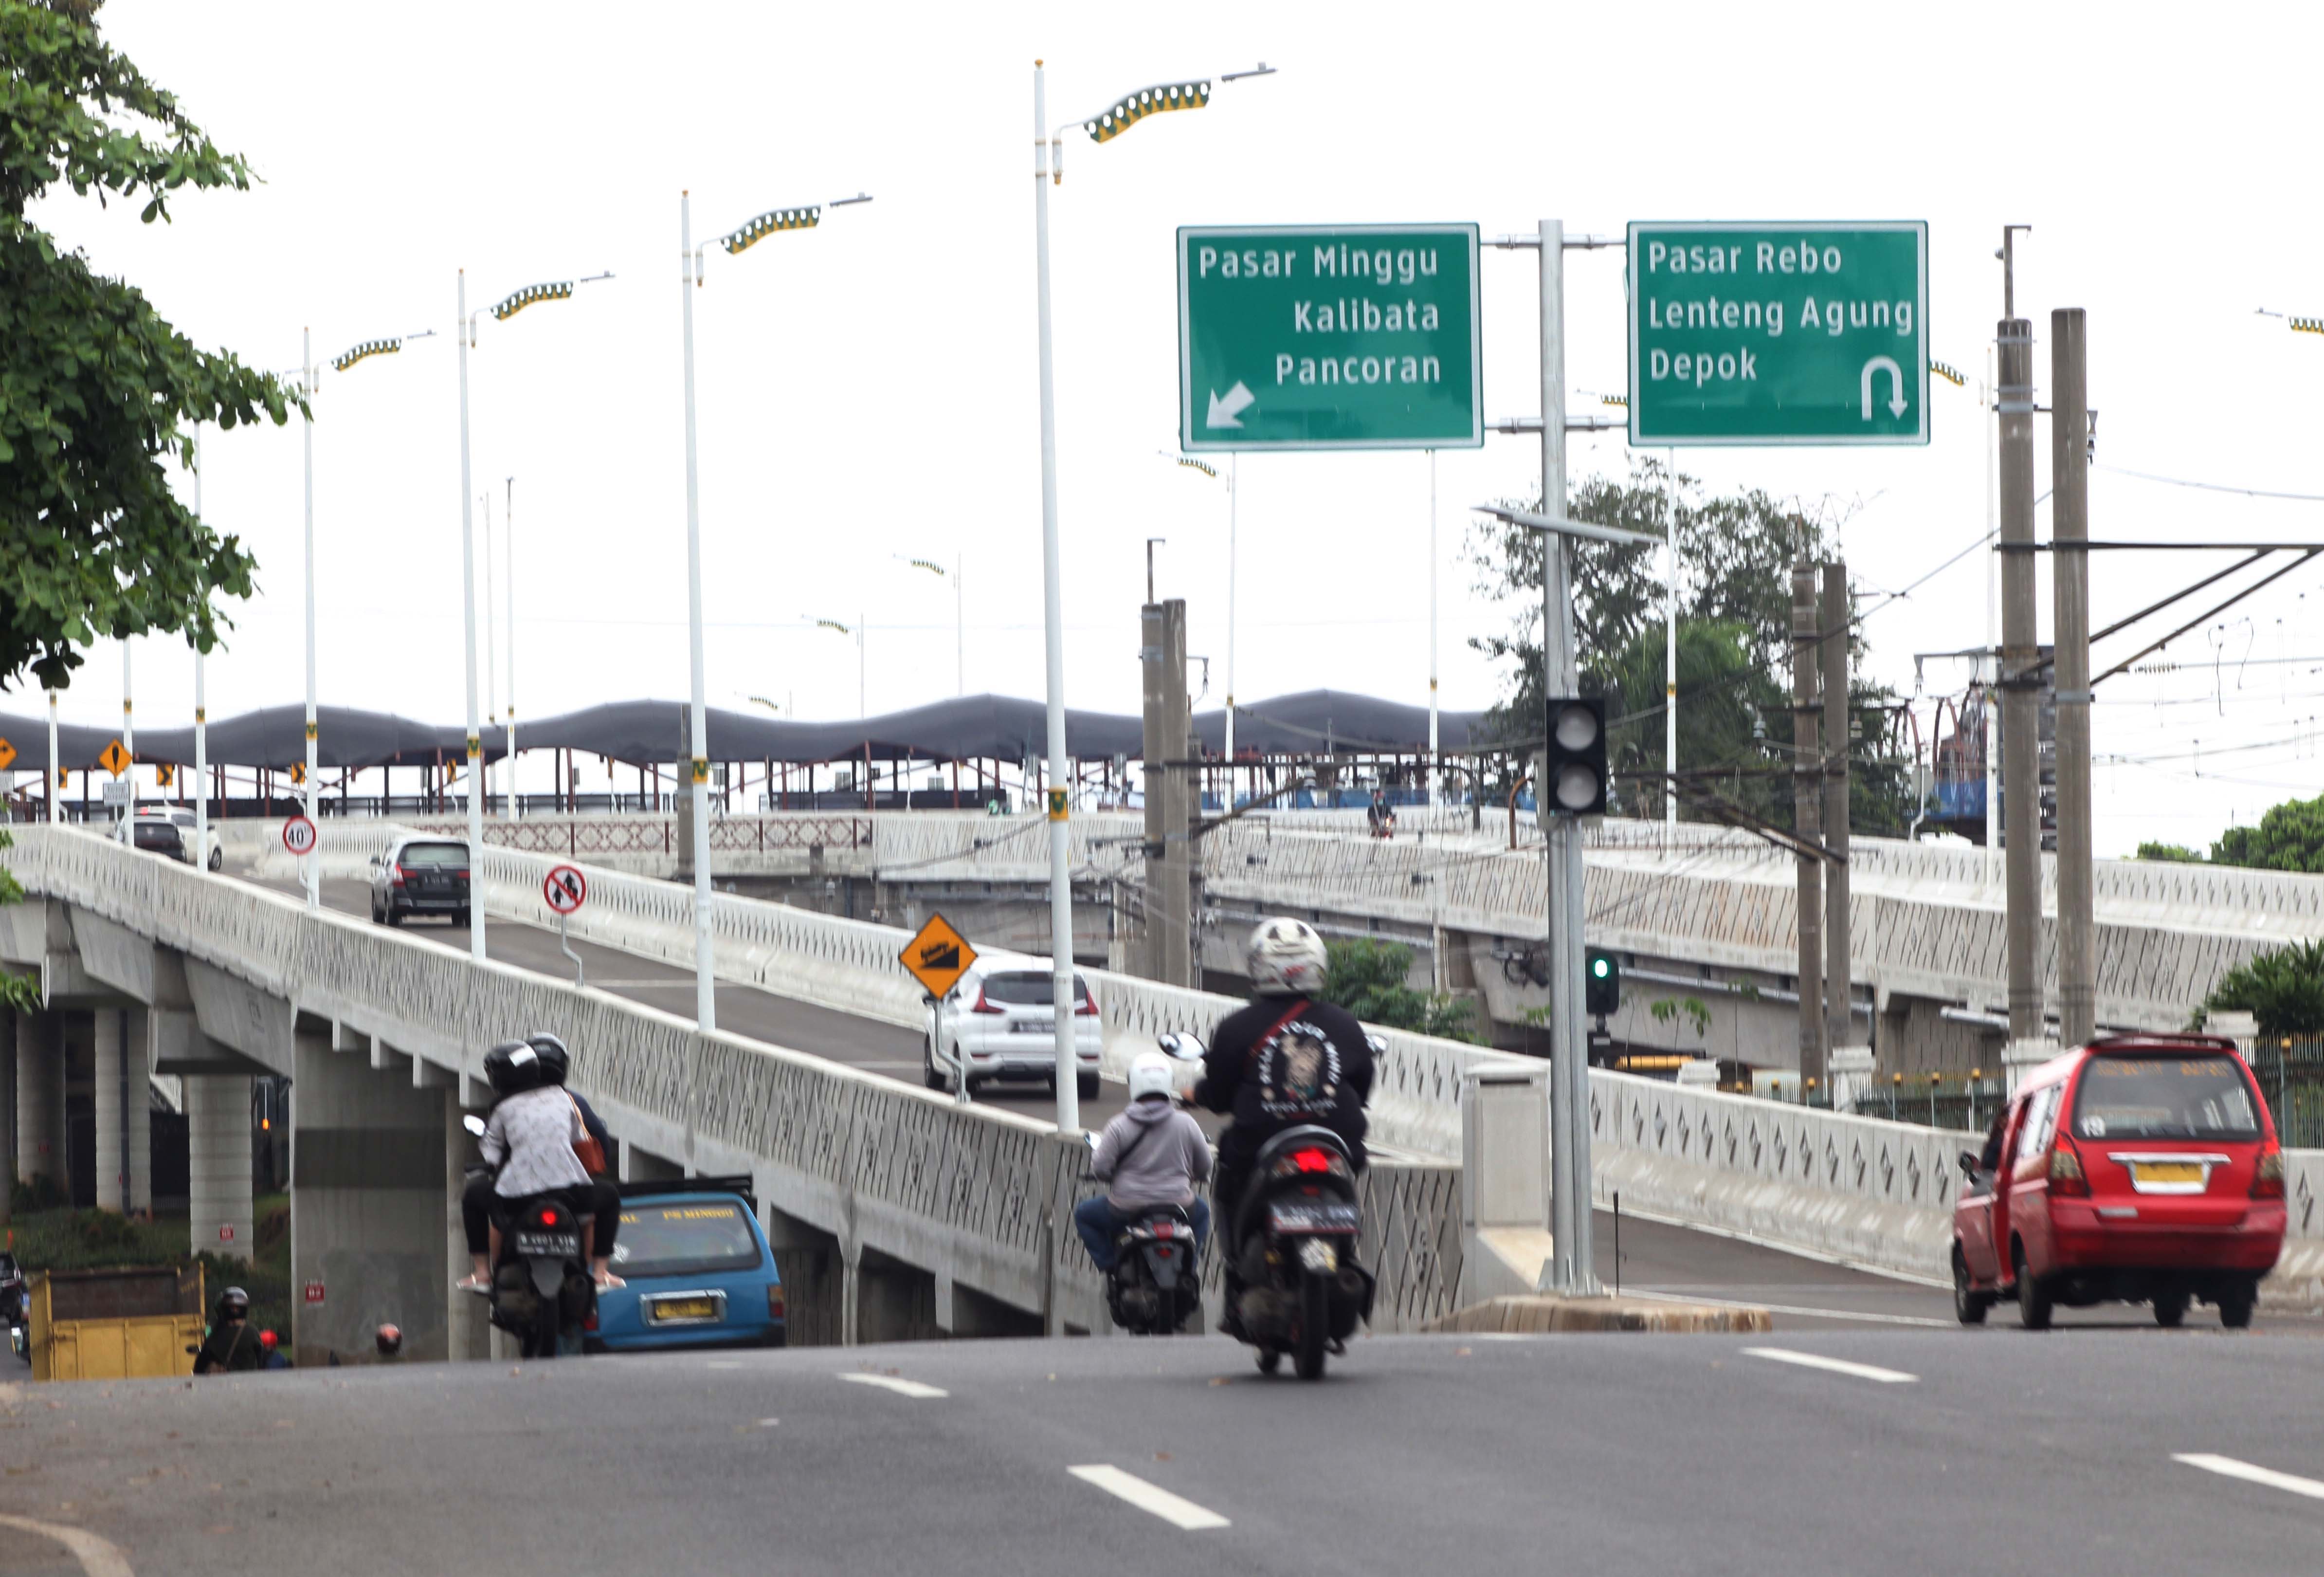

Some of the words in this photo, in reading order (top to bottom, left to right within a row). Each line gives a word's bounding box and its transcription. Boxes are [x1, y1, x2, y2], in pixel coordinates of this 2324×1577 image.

[1199, 247, 1296, 277] Pasar
[1314, 244, 1437, 284] Minggu
[1649, 241, 1742, 273] Pasar
[1757, 239, 1841, 273] Rebo
[1295, 298, 1438, 331] Kalibata
[1650, 296, 1783, 336] Lenteng
[1800, 296, 1912, 336] Agung
[1276, 354, 1440, 385] Pancoran
[1651, 347, 1757, 387] Depok
